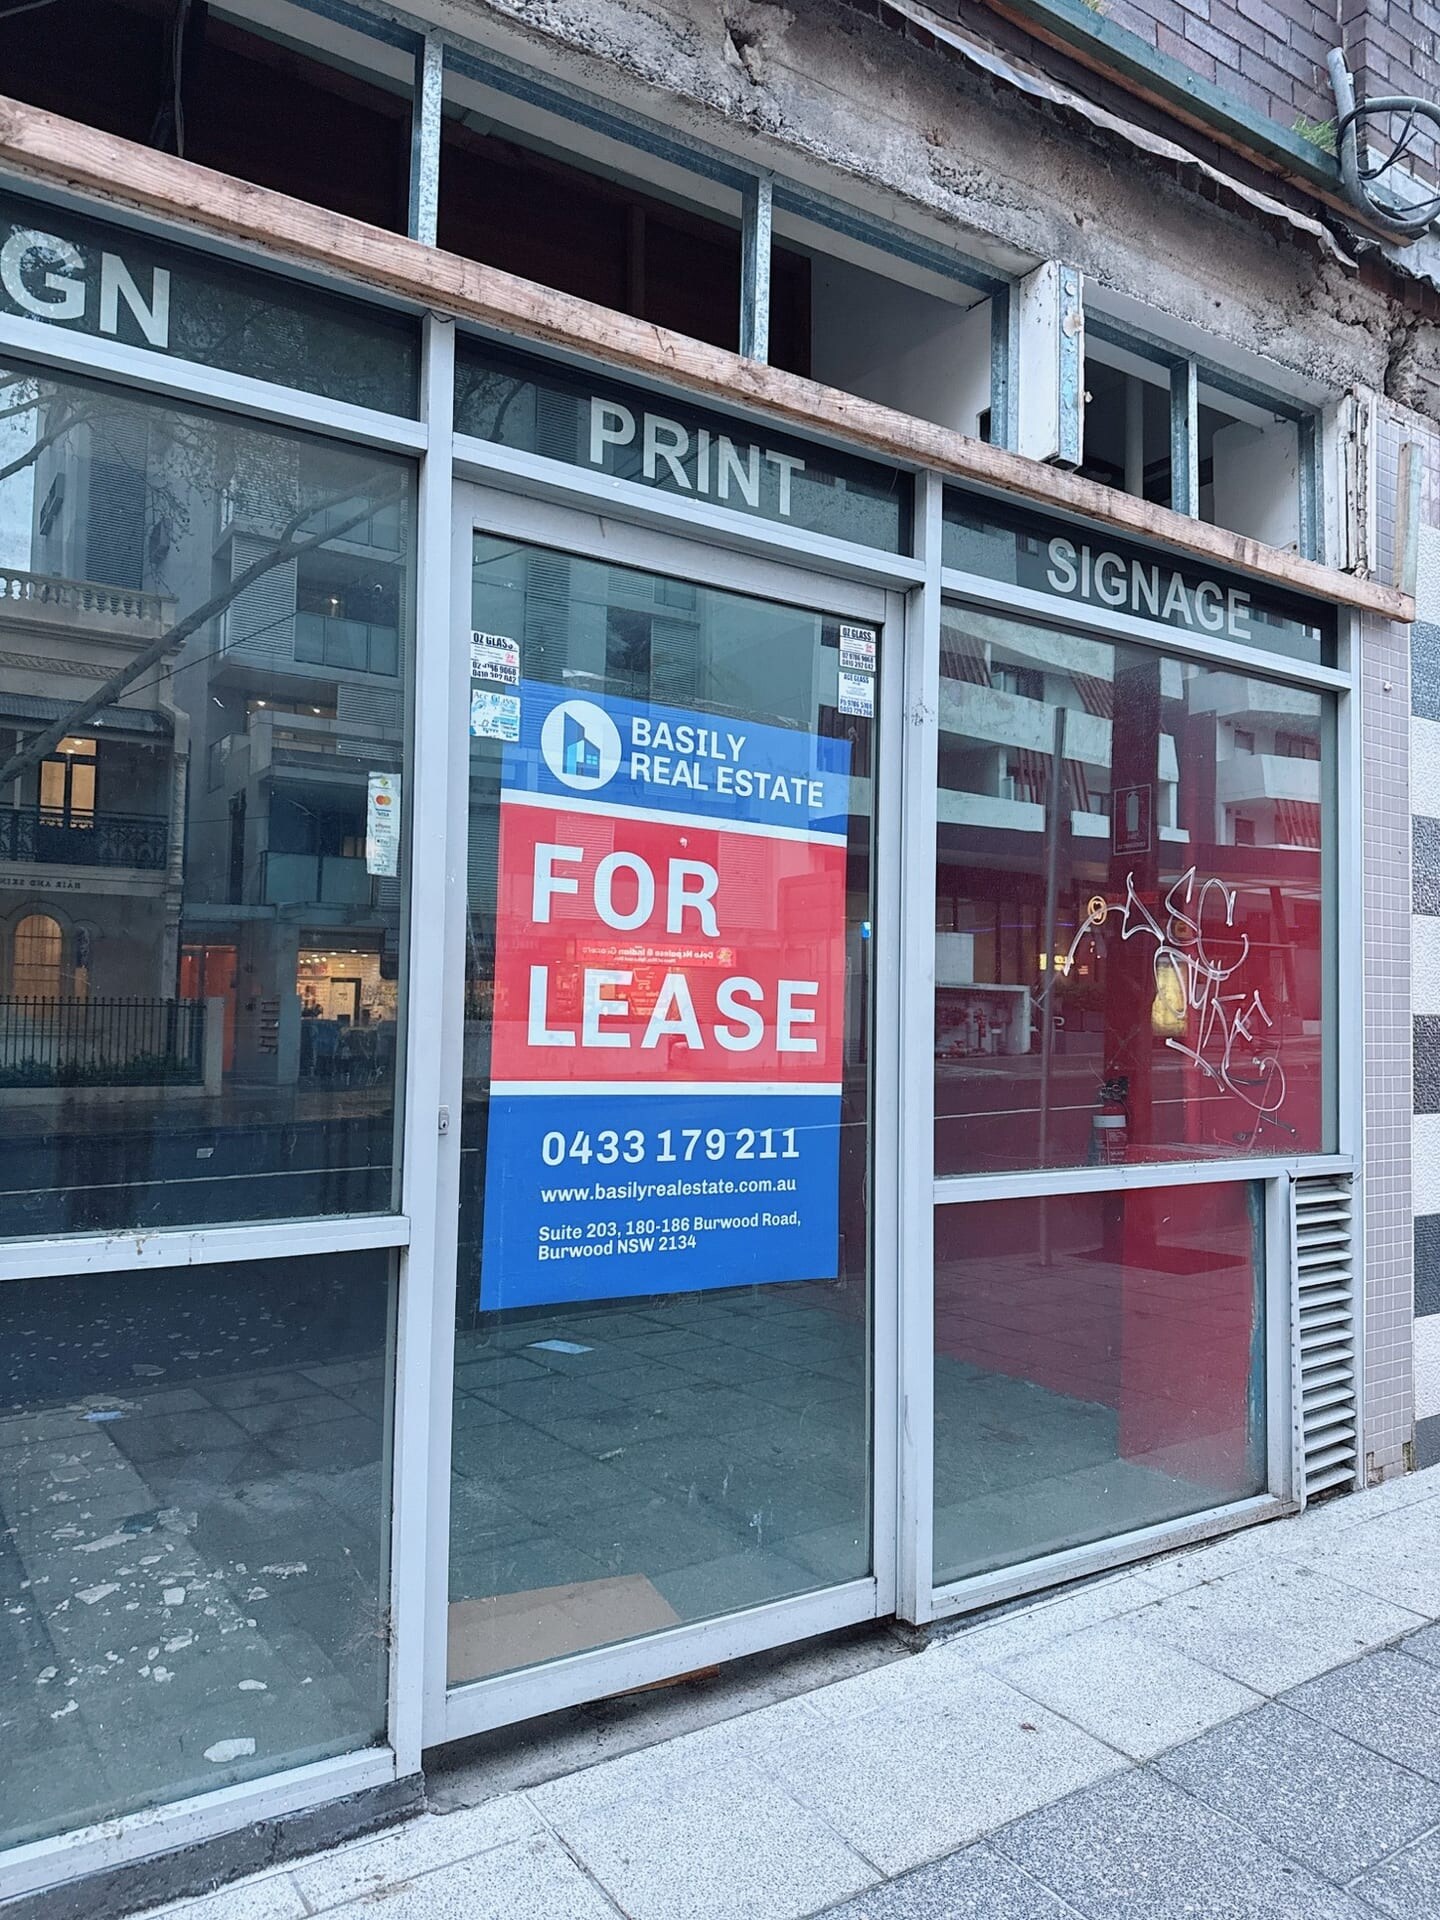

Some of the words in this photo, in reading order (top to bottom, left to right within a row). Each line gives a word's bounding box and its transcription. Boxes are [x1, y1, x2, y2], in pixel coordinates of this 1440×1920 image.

[588, 396, 805, 517] PRINT
[1046, 537, 1252, 640] SIGNAGE
[851, 628, 872, 641] GLASS
[854, 674, 869, 684] GLASS
[631, 717, 746, 762] BASILY
[630, 752, 708, 790] REAL
[717, 767, 824, 808] ESTATE
[532, 843, 720, 937] FOR
[527, 965, 819, 1053] LEASE
[541, 1130, 645, 1166] 0433
[656, 1128, 726, 1162] 179
[735, 1127, 800, 1159] 211
[540, 1177, 797, 1202] www.basilyrealestate.com.au
[538, 1223, 583, 1242] Suite
[586, 1221, 622, 1239] 203,
[625, 1217, 690, 1236] 180-186
[694, 1213, 759, 1231] Burwood
[762, 1211, 801, 1227] Road,
[538, 1240, 613, 1261] Burwood
[617, 1238, 654, 1254] NSW
[658, 1235, 697, 1252] 2134
